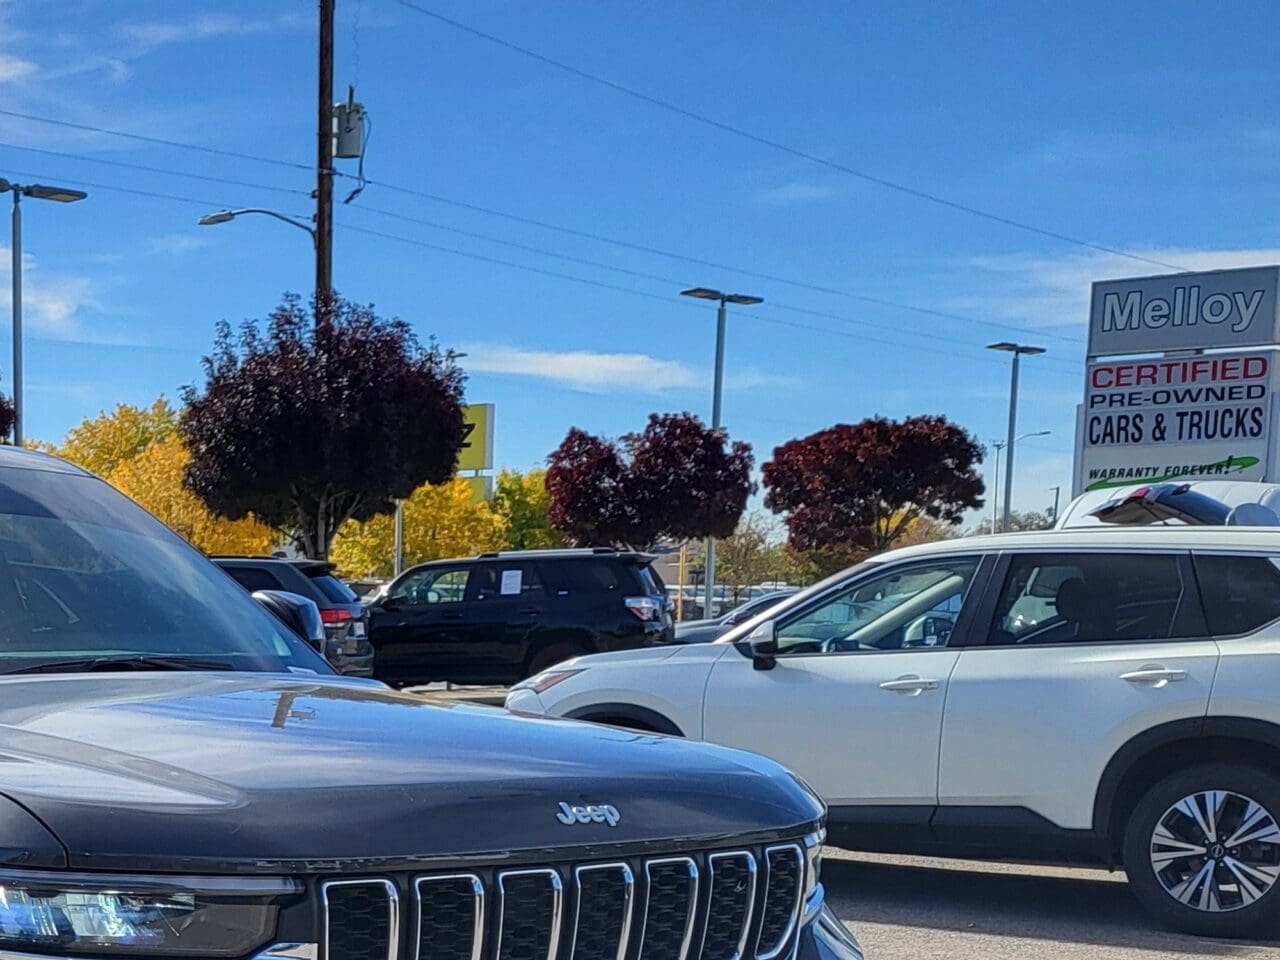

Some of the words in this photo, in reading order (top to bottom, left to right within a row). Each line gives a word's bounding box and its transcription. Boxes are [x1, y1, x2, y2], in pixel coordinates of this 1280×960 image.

[1101, 285, 1265, 333] Melloy
[1091, 357, 1268, 388] CERTIFIED
[1090, 384, 1266, 409] PRE-OWNED
[1089, 413, 1144, 445] CARS
[1151, 412, 1167, 442] &
[1176, 407, 1264, 440] TRUCKS
[1088, 465, 1160, 480] WARRANTY
[556, 802, 620, 827] Jeep
